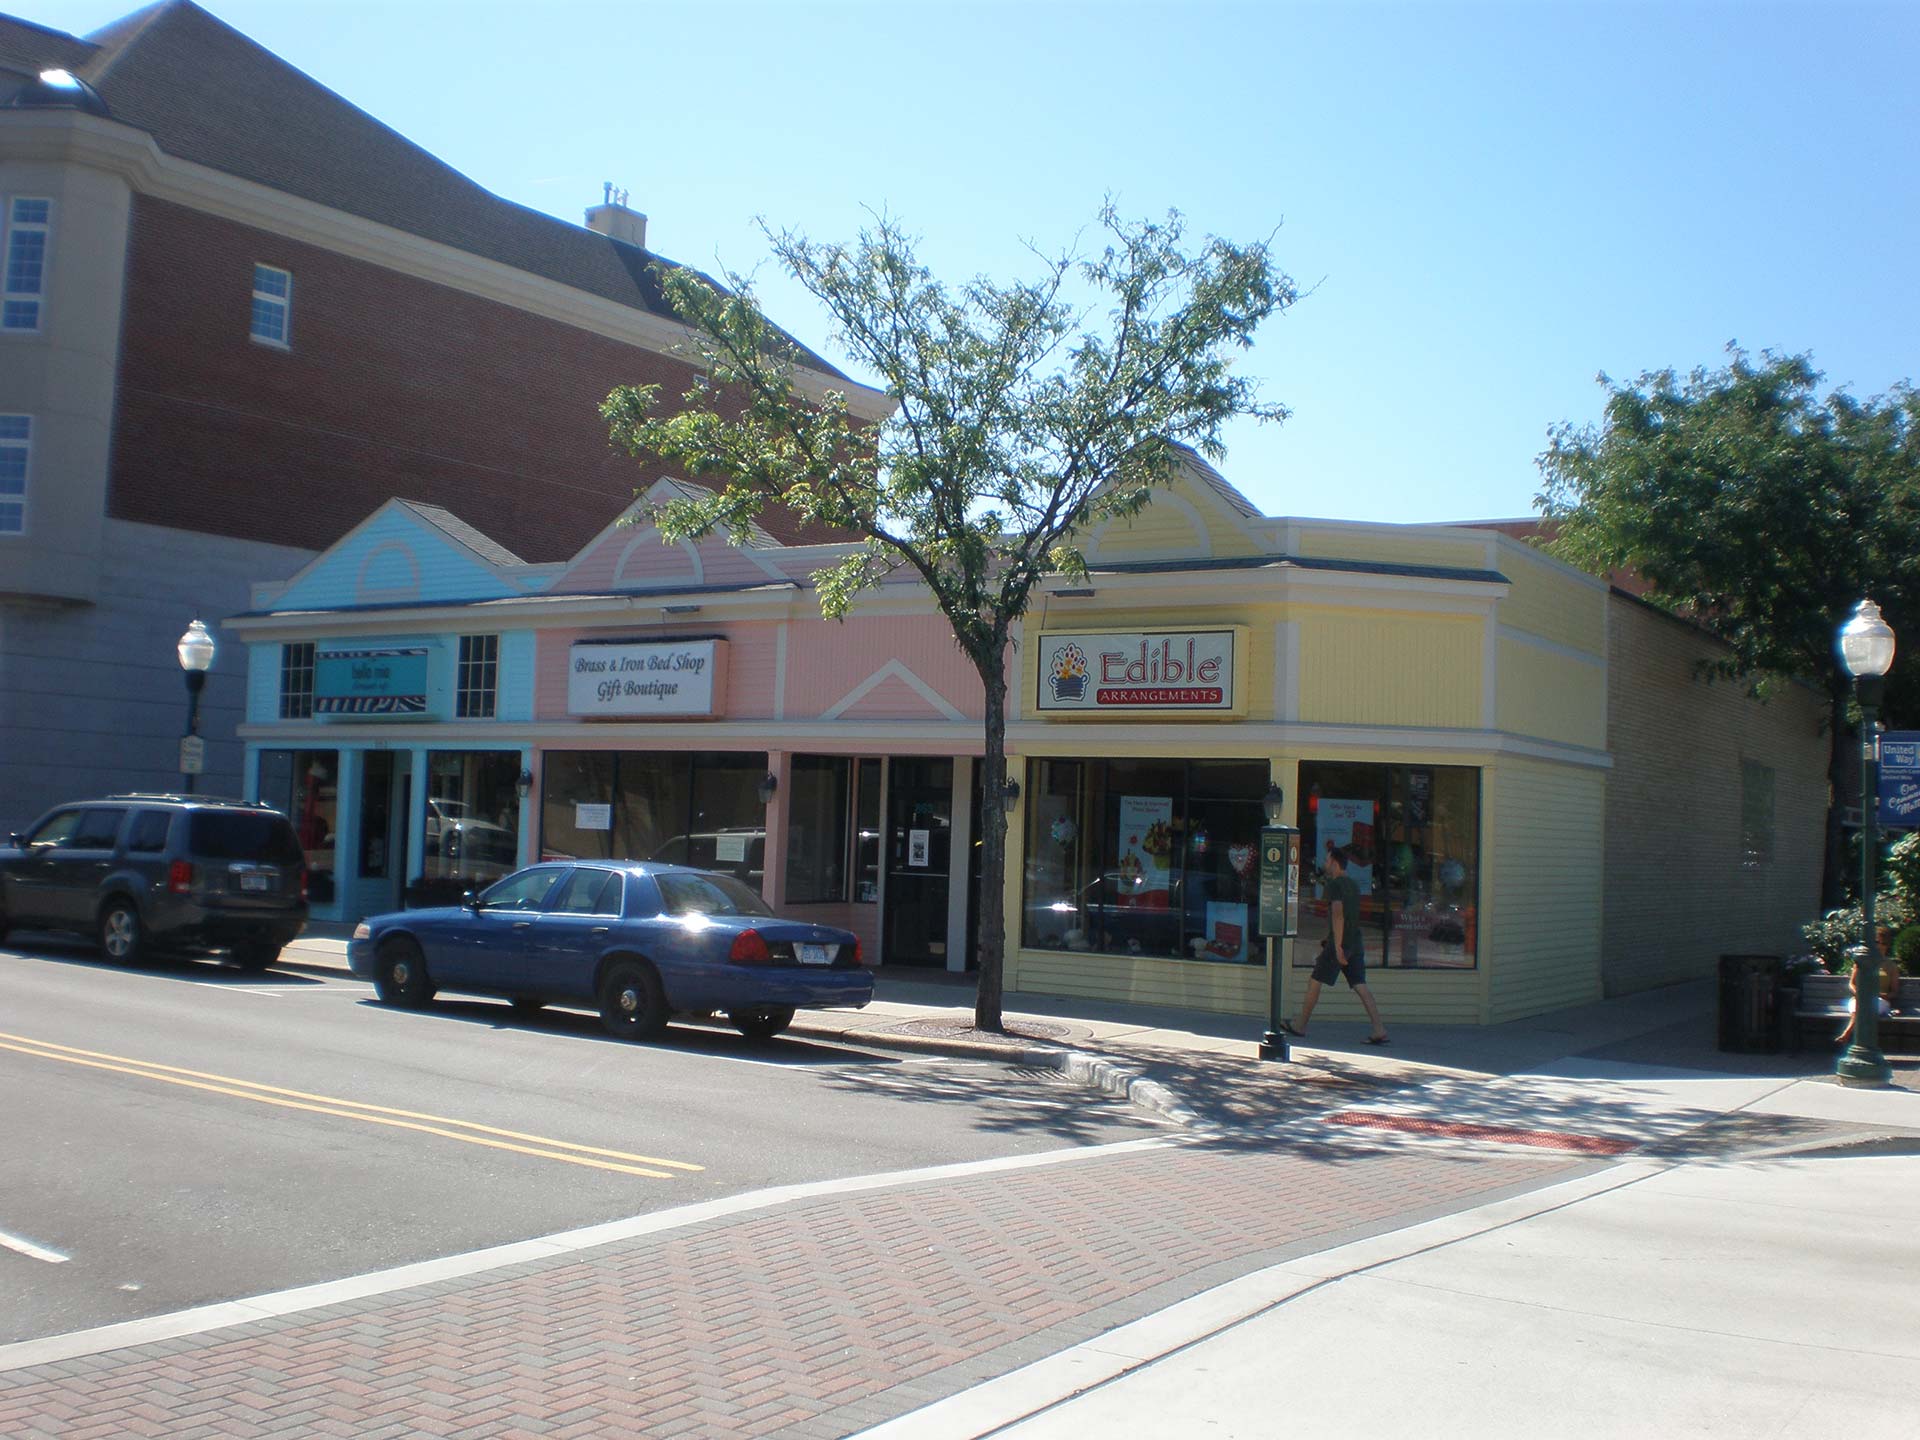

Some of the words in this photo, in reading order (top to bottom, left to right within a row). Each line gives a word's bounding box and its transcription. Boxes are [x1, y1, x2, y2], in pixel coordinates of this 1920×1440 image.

[575, 657, 606, 672] Brass
[609, 659, 616, 671] &
[619, 656, 644, 671] Iron
[647, 652, 674, 670] Bed
[673, 652, 705, 674] Shop
[1100, 638, 1219, 684] Edible
[597, 679, 621, 701] Gift
[623, 679, 678, 700] Boutique
[1101, 689, 1218, 701] ARRANGEMENTS
[1884, 745, 1914, 754] United
[1896, 755, 1914, 765] Way
